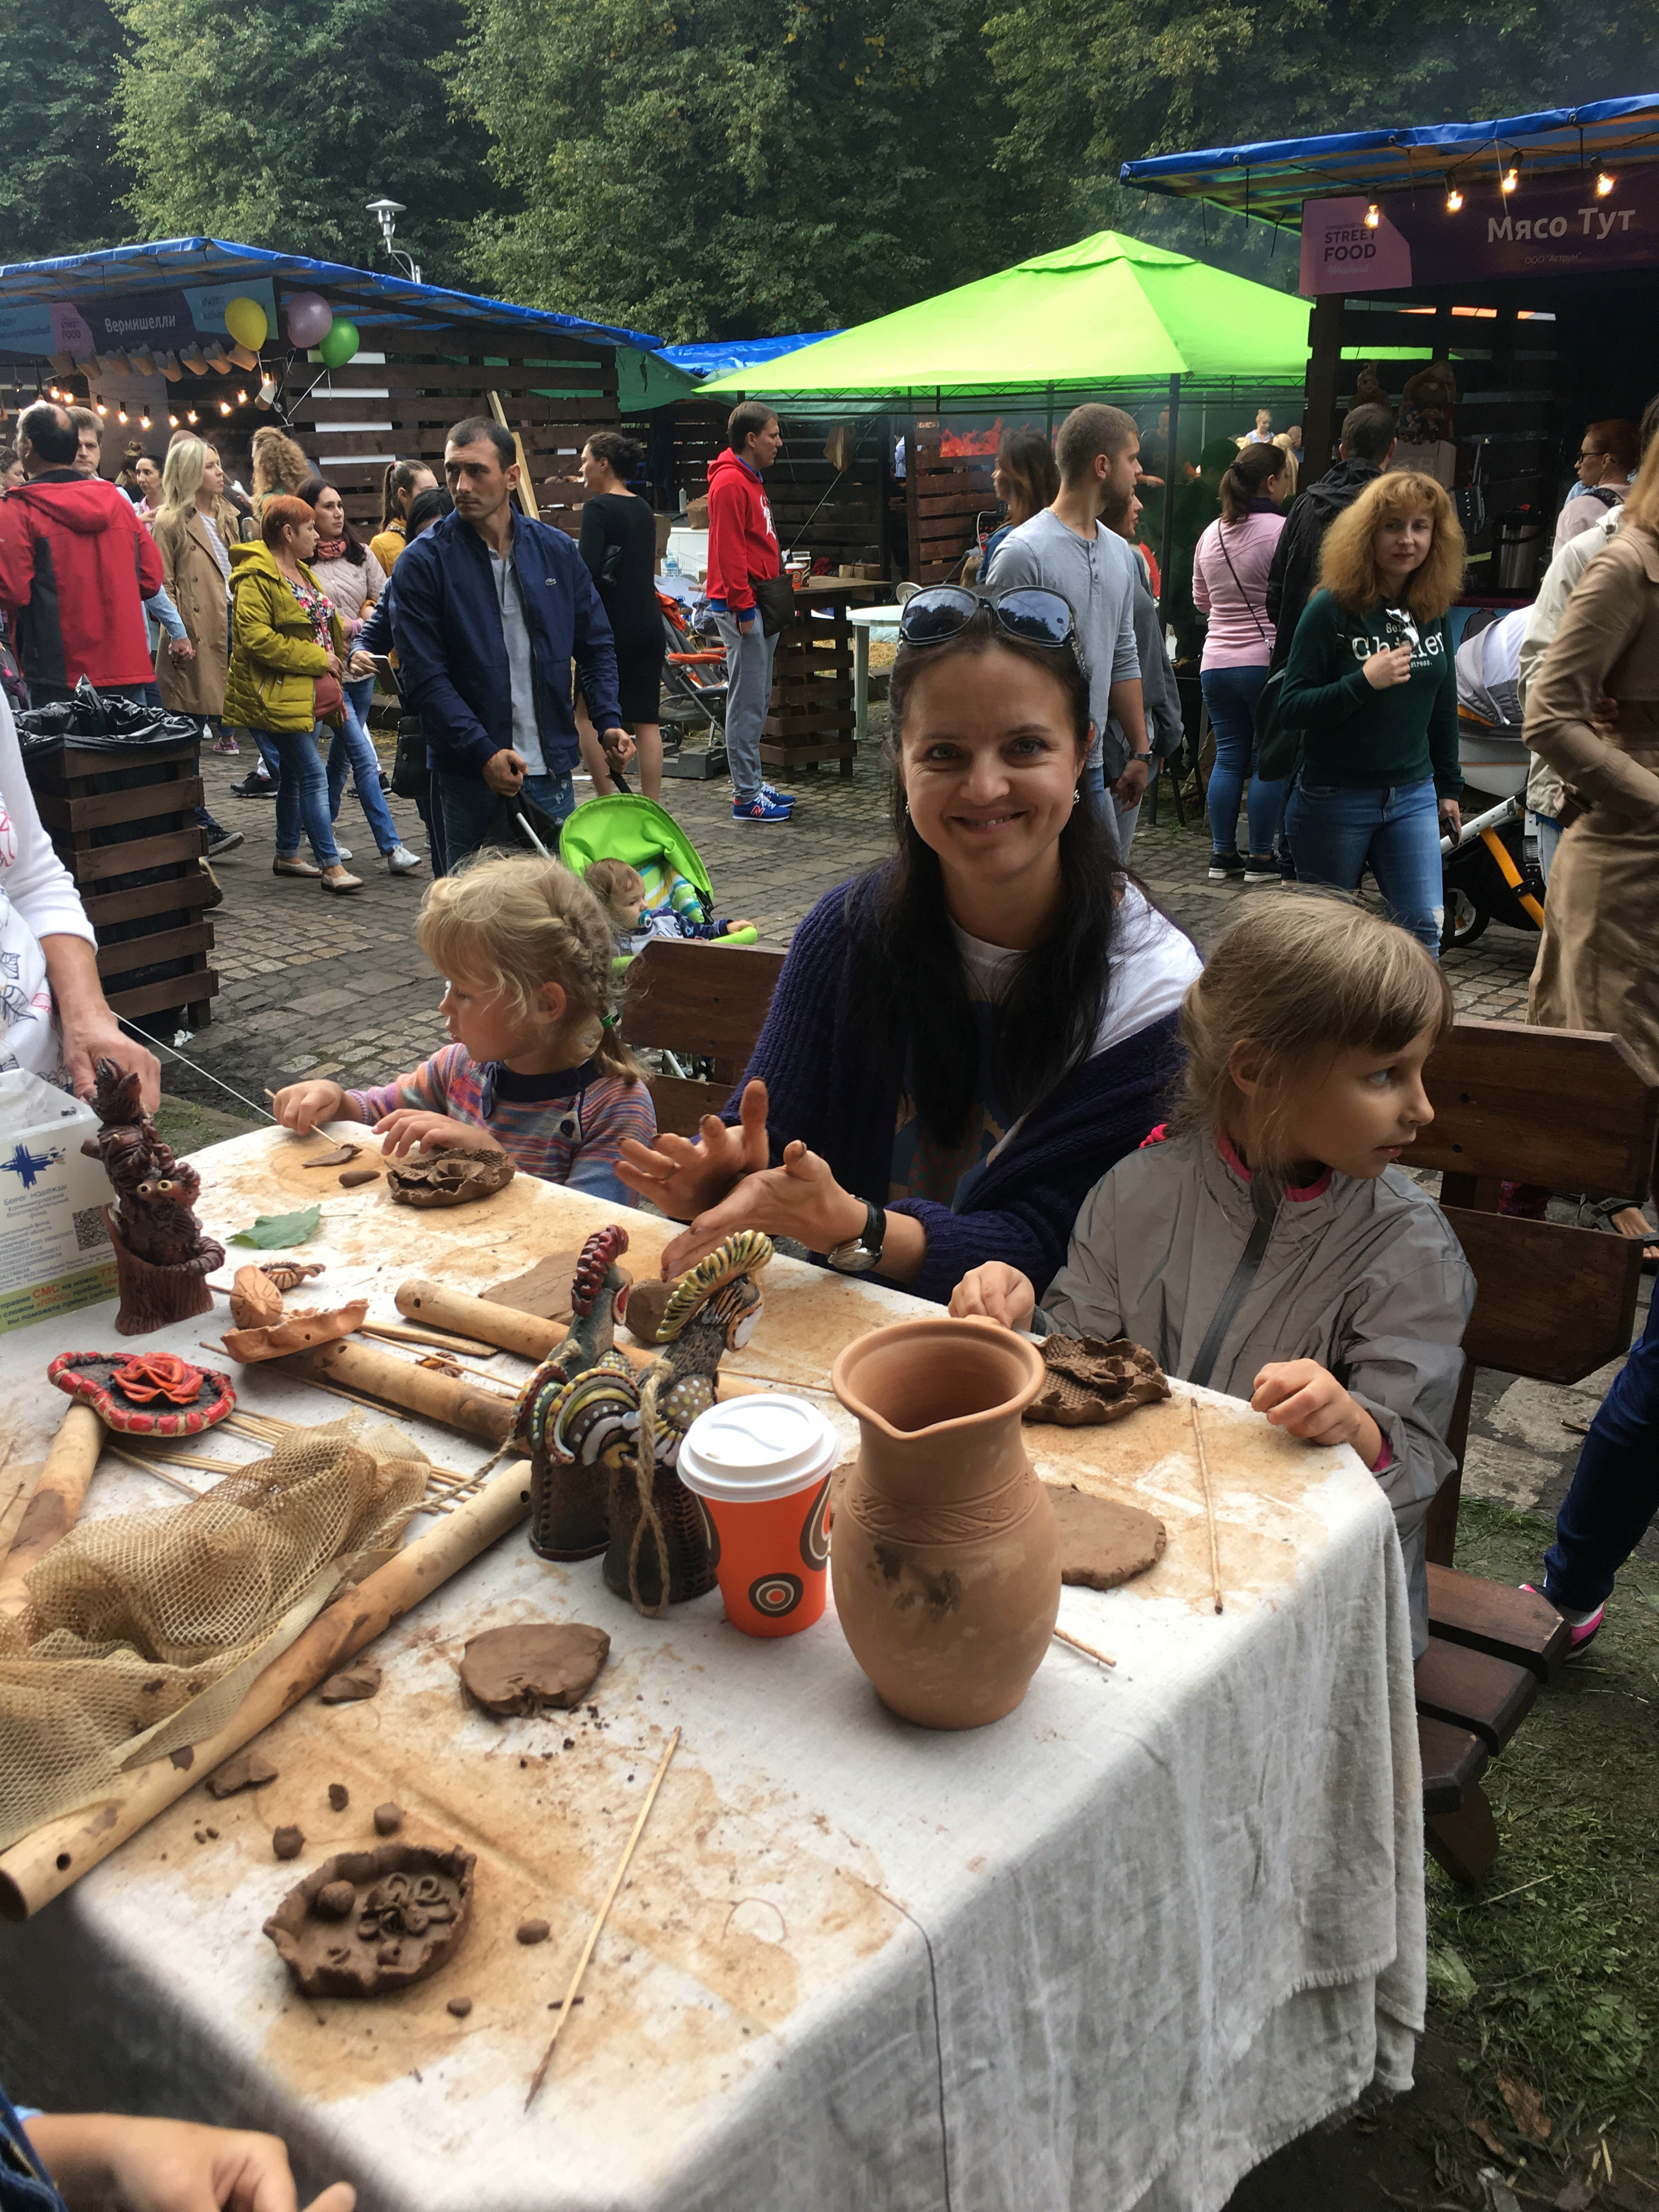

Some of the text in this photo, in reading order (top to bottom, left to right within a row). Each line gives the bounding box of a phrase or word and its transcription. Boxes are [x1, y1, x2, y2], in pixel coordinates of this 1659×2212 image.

[1487, 207, 1636, 242] Мясо Тут
[1324, 228, 1378, 244] STREET
[1324, 244, 1376, 262] FOOD
[1525, 255, 1544, 264] ООО
[60, 320, 80, 329] STREET
[104, 314, 176, 335] Вермишелли
[62, 330, 81, 340] FOOD
[751, 805, 766, 817] N
[0, 1296, 31, 1309] правив
[32, 1284, 60, 1299] СМС
[74, 1276, 98, 1286] номер
[3, 1304, 34, 1318] словом
[72, 1283, 102, 1296] пробел
[21, 1305, 61, 1321] поможете
[63, 1296, 88, 1308] прямо
[89, 1286, 116, 1299] сейчас
